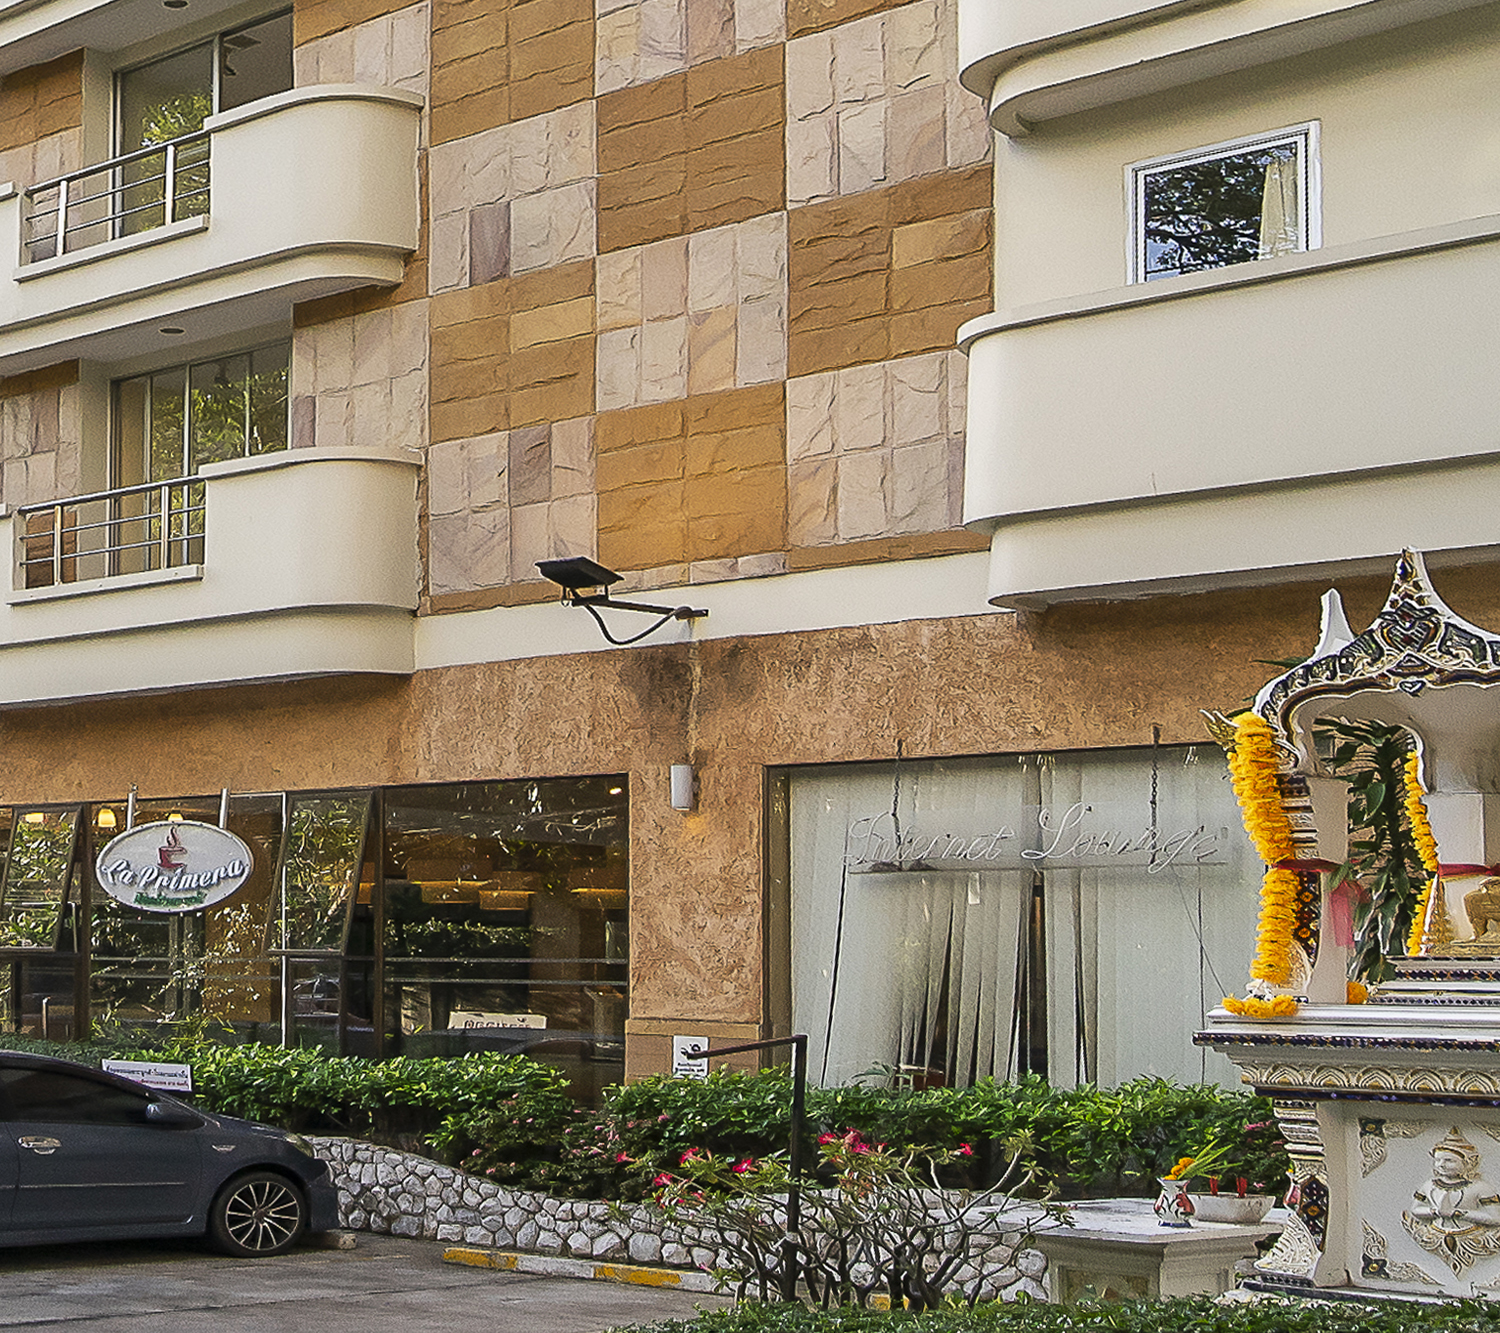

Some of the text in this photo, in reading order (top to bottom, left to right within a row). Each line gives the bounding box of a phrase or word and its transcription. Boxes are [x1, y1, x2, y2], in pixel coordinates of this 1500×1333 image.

[842, 801, 1219, 874] Internet Lounge
[101, 858, 245, 891] La Primera
